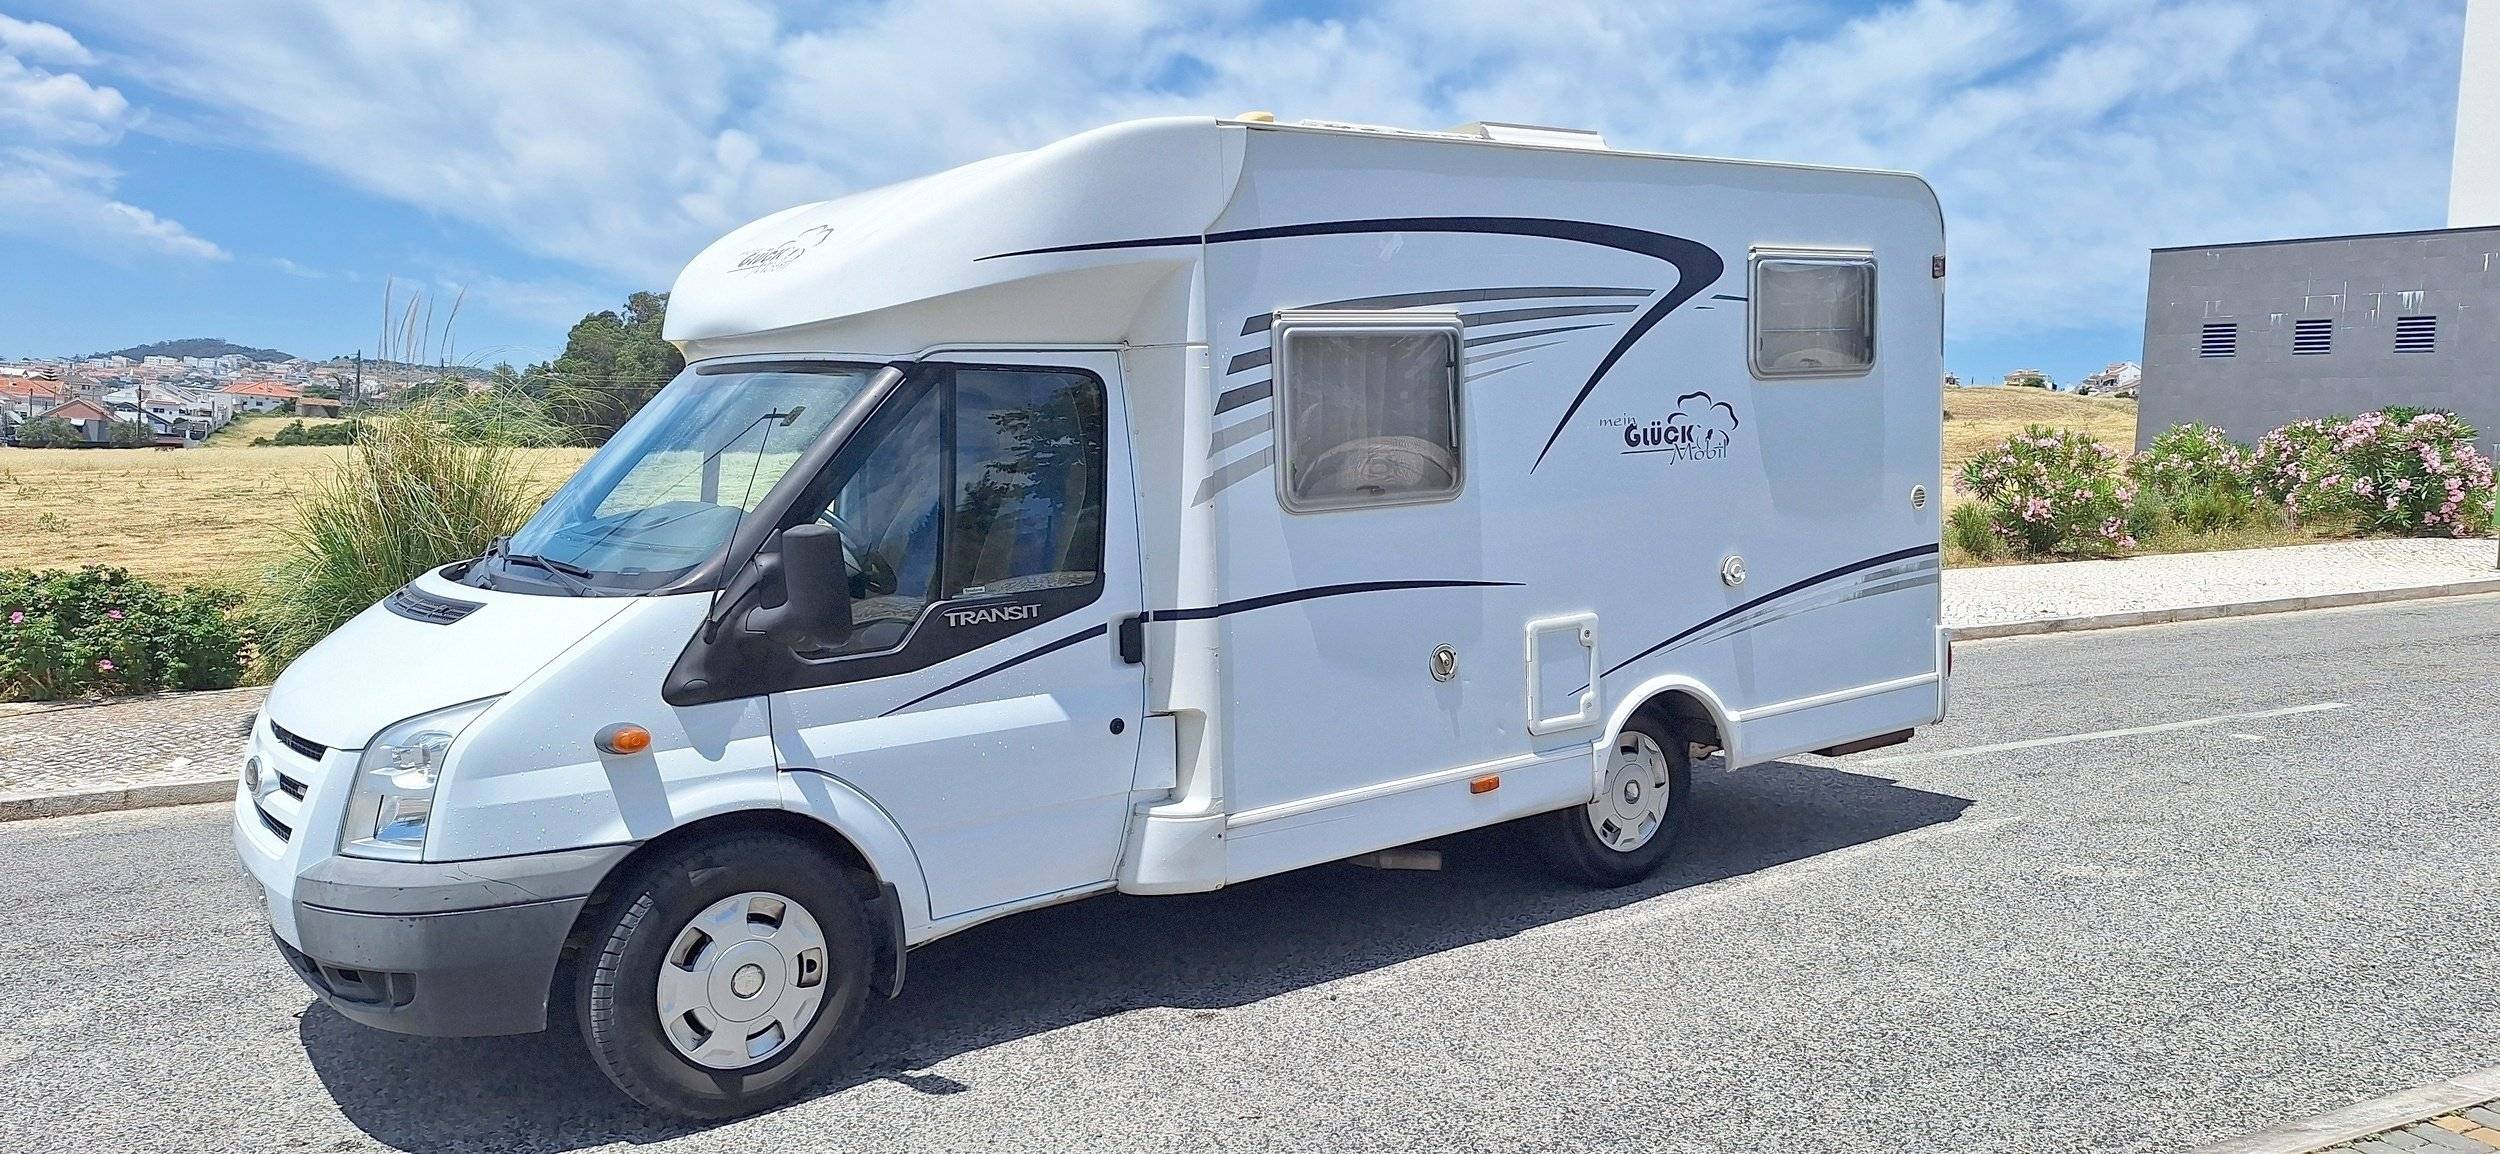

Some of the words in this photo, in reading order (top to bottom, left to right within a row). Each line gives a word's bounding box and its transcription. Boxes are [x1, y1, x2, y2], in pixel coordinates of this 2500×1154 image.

[1599, 413, 1636, 427] mein
[1624, 421, 1694, 447] GLÜCK
[1670, 439, 1727, 465] Mobil
[944, 604, 1041, 627] TRANSIT
